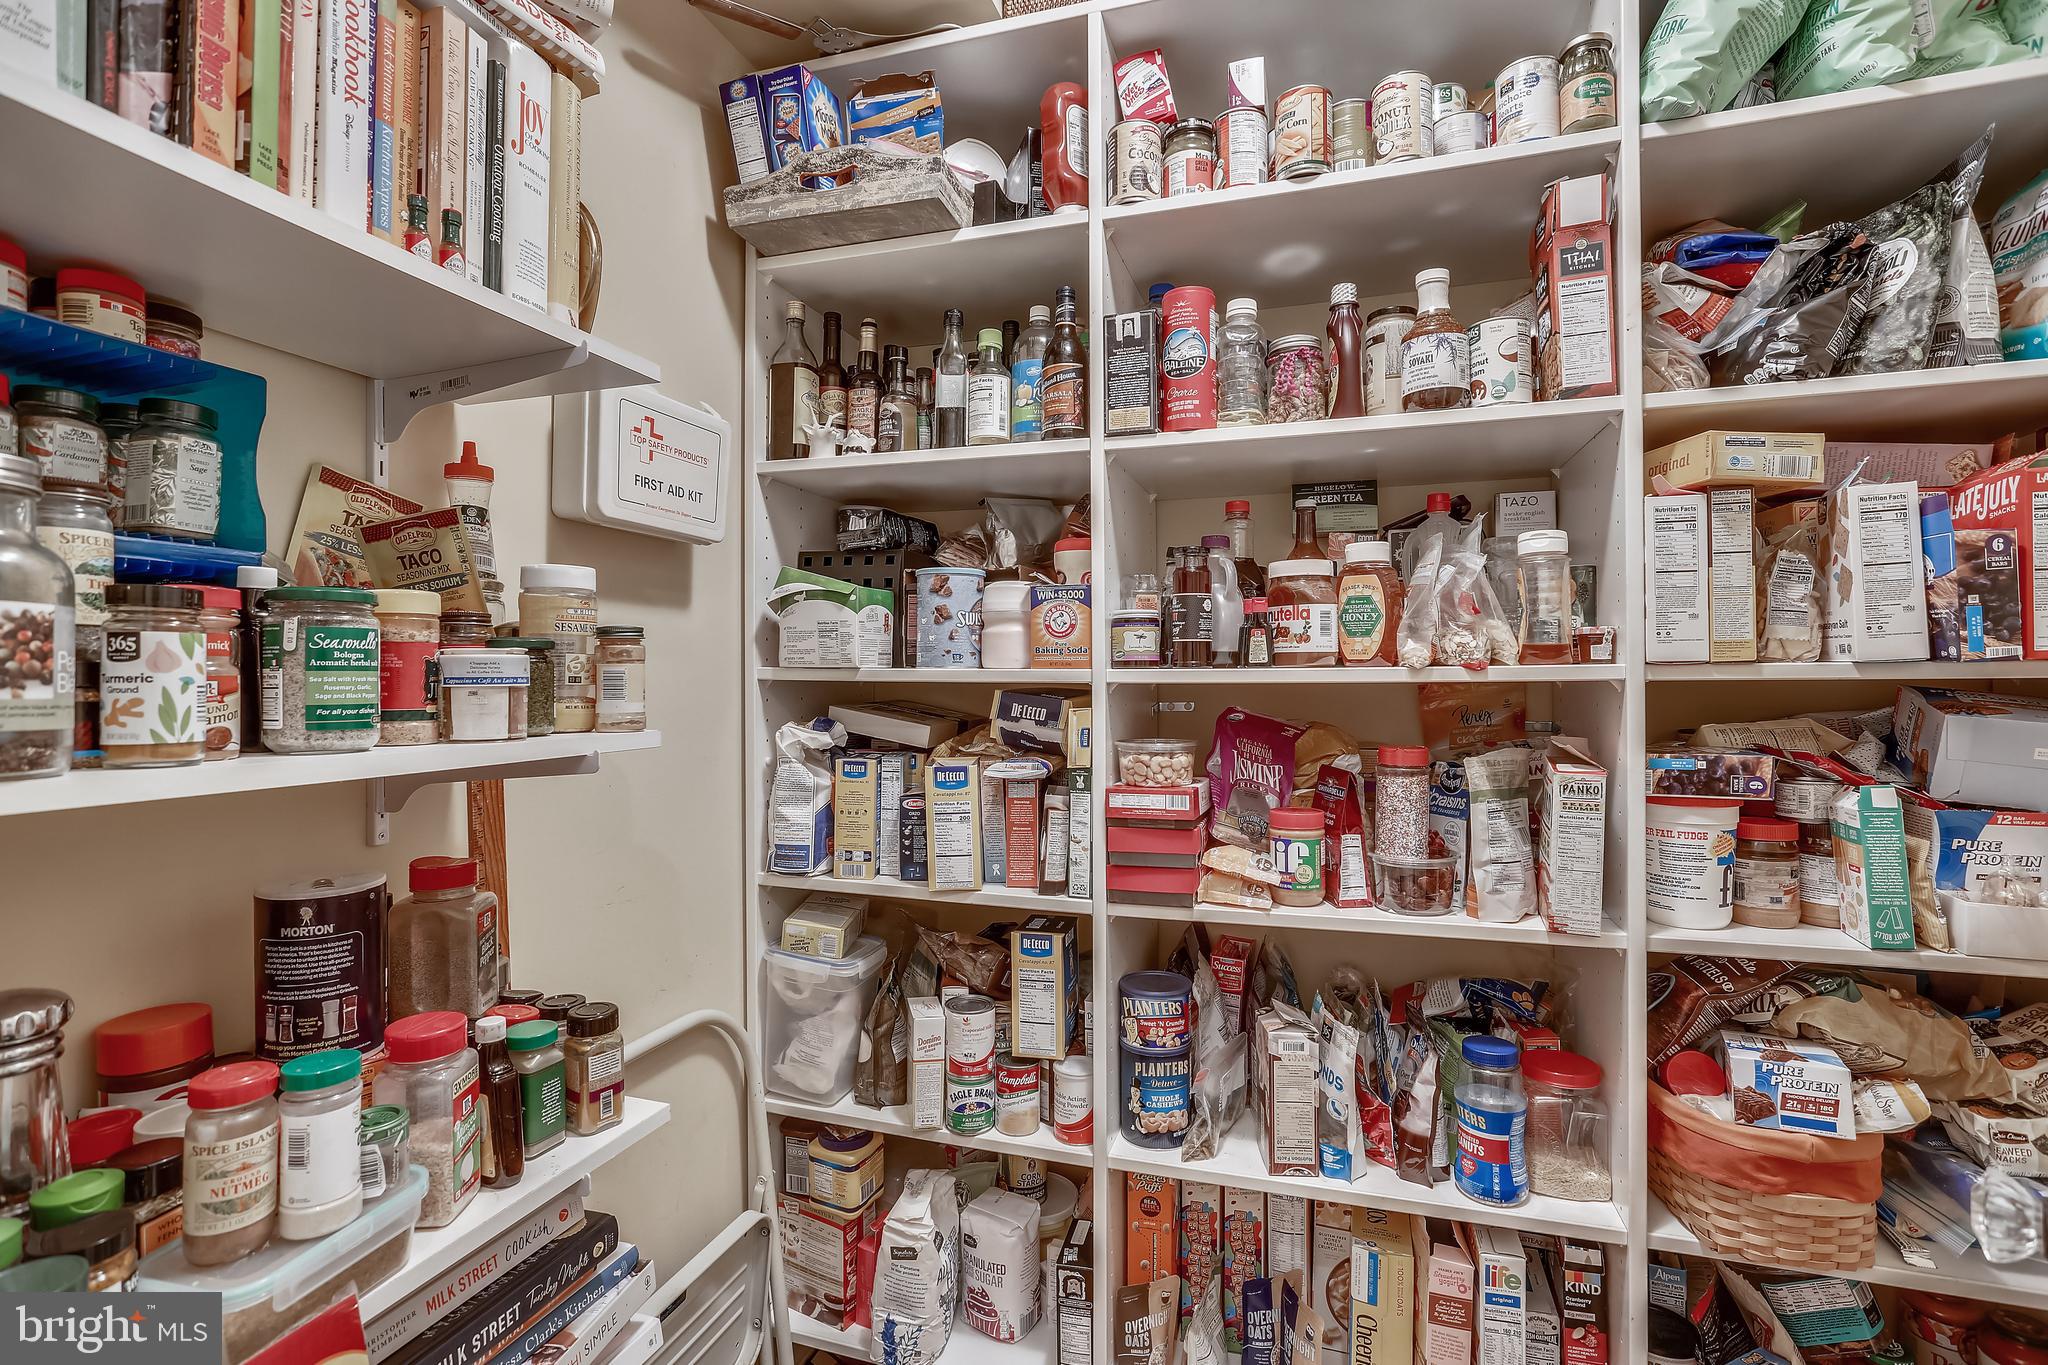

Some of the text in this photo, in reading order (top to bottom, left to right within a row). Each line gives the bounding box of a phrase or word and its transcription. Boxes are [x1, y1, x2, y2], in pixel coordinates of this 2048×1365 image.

[1820, 43, 1840, 60] FAKE.
[383, 23, 395, 122] Mark Bittman's
[495, 78, 504, 141] WILLIAMS-SONOMA
[511, 81, 548, 155] joy
[1286, 118, 1308, 130] Corn
[1380, 117, 1411, 138] MILK
[258, 142, 272, 154] LAKE
[260, 151, 271, 162] ISLE
[257, 158, 273, 172] PRESS
[374, 124, 394, 235] Kitchen Express
[518, 162, 547, 183] ROMBAUER
[490, 143, 504, 244] Outdoor Cooking
[524, 181, 542, 197] BECKER
[1563, 249, 1600, 266] THAI
[1569, 263, 1596, 271] KITCHEN
[1408, 353, 1434, 368] SOYAKI
[1934, 350, 1957, 359] (204g)
[1164, 359, 1204, 371] BALEINE
[1167, 387, 1199, 400] Coarse
[632, 432, 708, 465] TOP SAFETY PRODUCTS
[54, 449, 100, 464] Cardamom
[189, 464, 208, 474] Sage
[1648, 454, 1690, 477] original
[634, 474, 703, 503] FIRST AID KIT
[1342, 493, 1363, 502] TEA
[1503, 496, 1538, 507] TAZO
[1951, 476, 2021, 520] LATE JULY
[460, 515, 480, 523] EDEN
[1989, 506, 2016, 519] SNACKS
[58, 532, 99, 546] SPICE
[320, 535, 364, 556] 25% LESS
[1992, 538, 2003, 551] 6
[396, 549, 443, 571] TACO
[395, 564, 452, 583] SEASONING MIX
[410, 577, 462, 593] LESS SODIUM
[1036, 589, 1085, 600] WIN $5,000
[1268, 608, 1311, 621] nutella
[1342, 612, 1379, 621] HONEY
[554, 622, 588, 633] SESAME
[1838, 619, 1848, 629] Salt
[108, 635, 137, 651] 365
[333, 651, 365, 659] Bologna
[1035, 646, 1088, 655] Baking Soda
[309, 659, 371, 667] Aromatic herbal
[106, 685, 139, 694] Ground
[1011, 703, 1046, 721] DE CECCO
[1452, 706, 1494, 727] Pereg
[937, 772, 965, 783] DE CECCO
[1318, 784, 1345, 797] GHIRARDELLI
[1562, 785, 1599, 796] PANKO
[1996, 815, 2012, 824] 12
[1656, 829, 1708, 840] FAIL FUDGE
[1951, 839, 2002, 852] PURE
[280, 923, 335, 938] MORTON
[1212, 961, 1241, 973] Success
[1123, 997, 1182, 1017] PLANTERS
[1165, 1019, 1185, 1027] Crunchy
[917, 1035, 941, 1047] Domino
[1135, 1061, 1188, 1076] PLANTERS
[1762, 1062, 1804, 1078] PURE
[998, 1071, 1038, 1086] Campbell's
[1150, 1079, 1178, 1088] Deluxe
[1771, 1075, 1839, 1094] PROTEIN
[950, 1090, 972, 1102] EAGLE
[1785, 1094, 1812, 1102] CHOCOLATE
[1146, 1100, 1183, 1108] CASHEWS
[1820, 1104, 1834, 1112] 180
[192, 1144, 229, 1158] SPICE
[1020, 1172, 1040, 1181] CORN
[209, 1172, 270, 1199] NUTMEG
[1135, 1181, 1163, 1194] Puffs
[963, 1250, 1006, 1275] GRANULATED
[974, 1271, 1003, 1288] SUGAR
[1485, 1264, 1522, 1290] life
[1655, 1268, 1681, 1282] Alpen
[425, 1254, 499, 1316] MILK STREET
[1565, 1281, 1601, 1296] KIND
[1565, 1296, 1591, 1304] Cranberry
[524, 1284, 605, 1353] Clark's Kitchen
[471, 1302, 521, 1354] STREET
[583, 1312, 618, 1356] SIMPLE
[1248, 1325, 1273, 1339] OATS
[370, 1326, 409, 1356] KIMBALL
[1125, 1334, 1149, 1347] OATS
